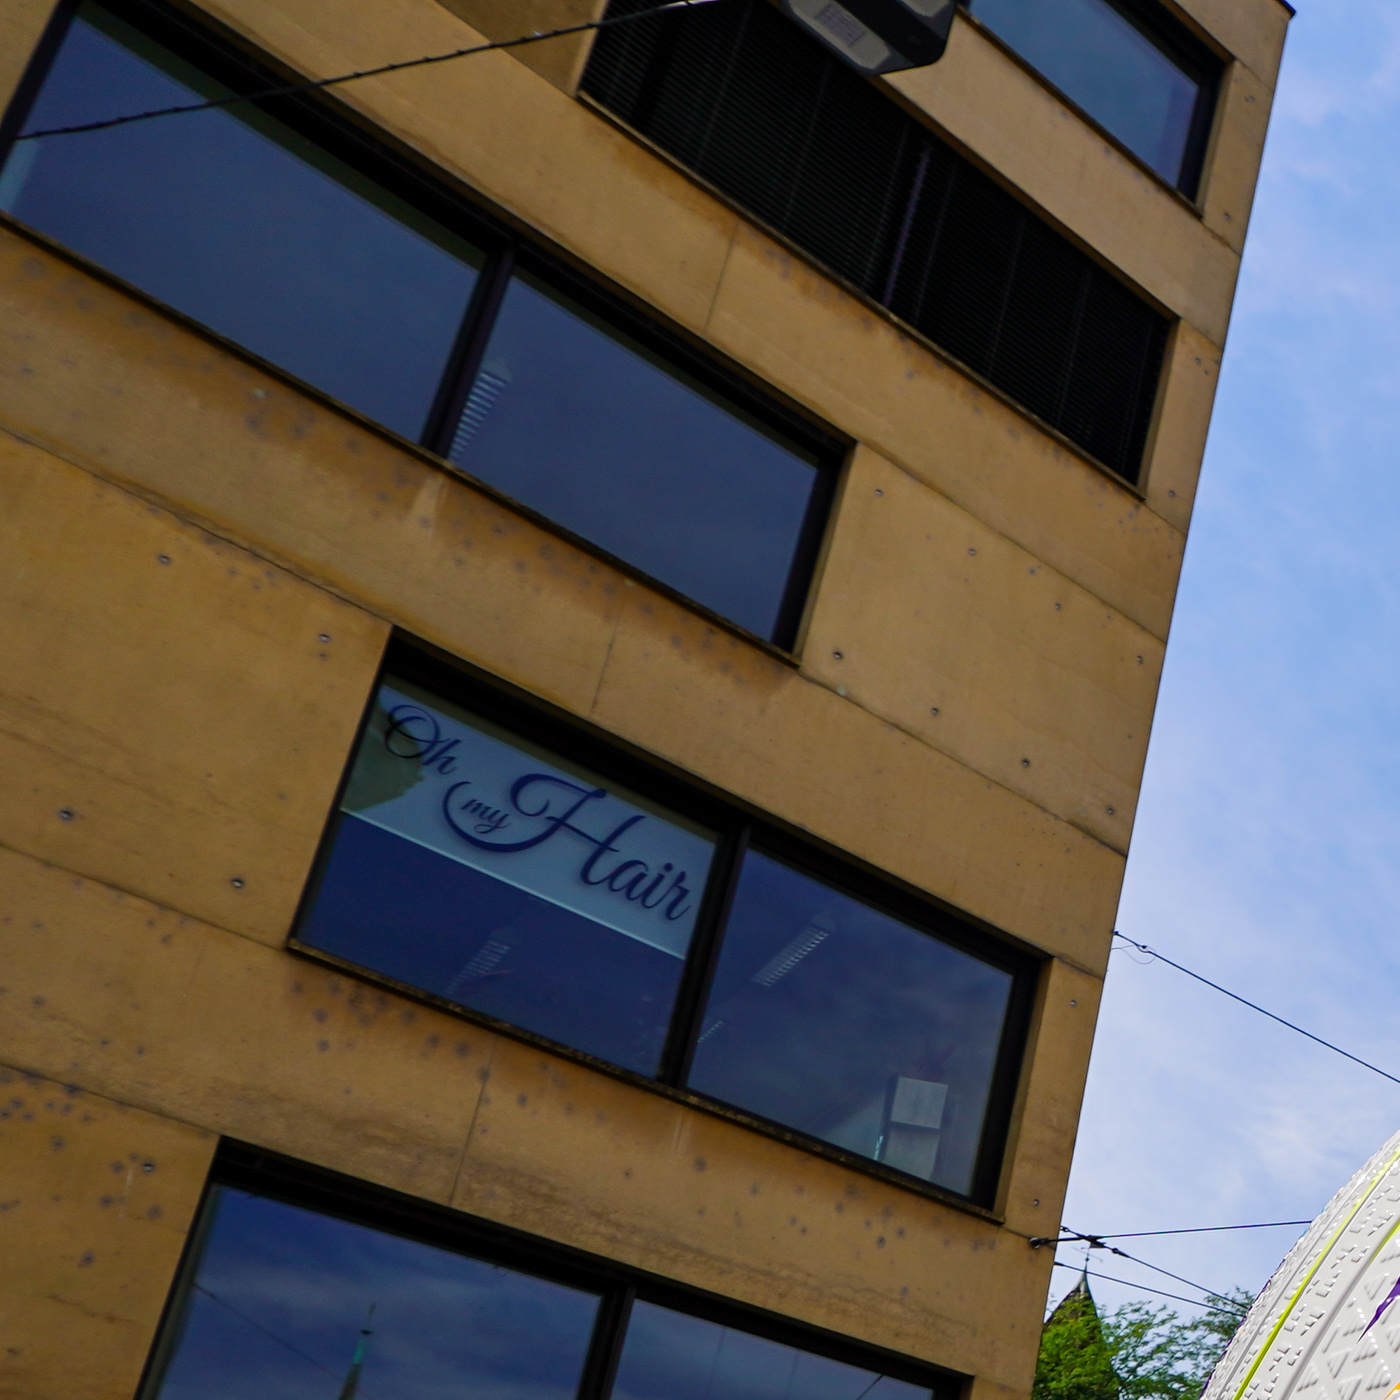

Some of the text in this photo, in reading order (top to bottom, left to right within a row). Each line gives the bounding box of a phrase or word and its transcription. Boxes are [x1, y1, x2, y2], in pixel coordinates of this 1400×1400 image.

[384, 704, 690, 921] Oh my Hair
